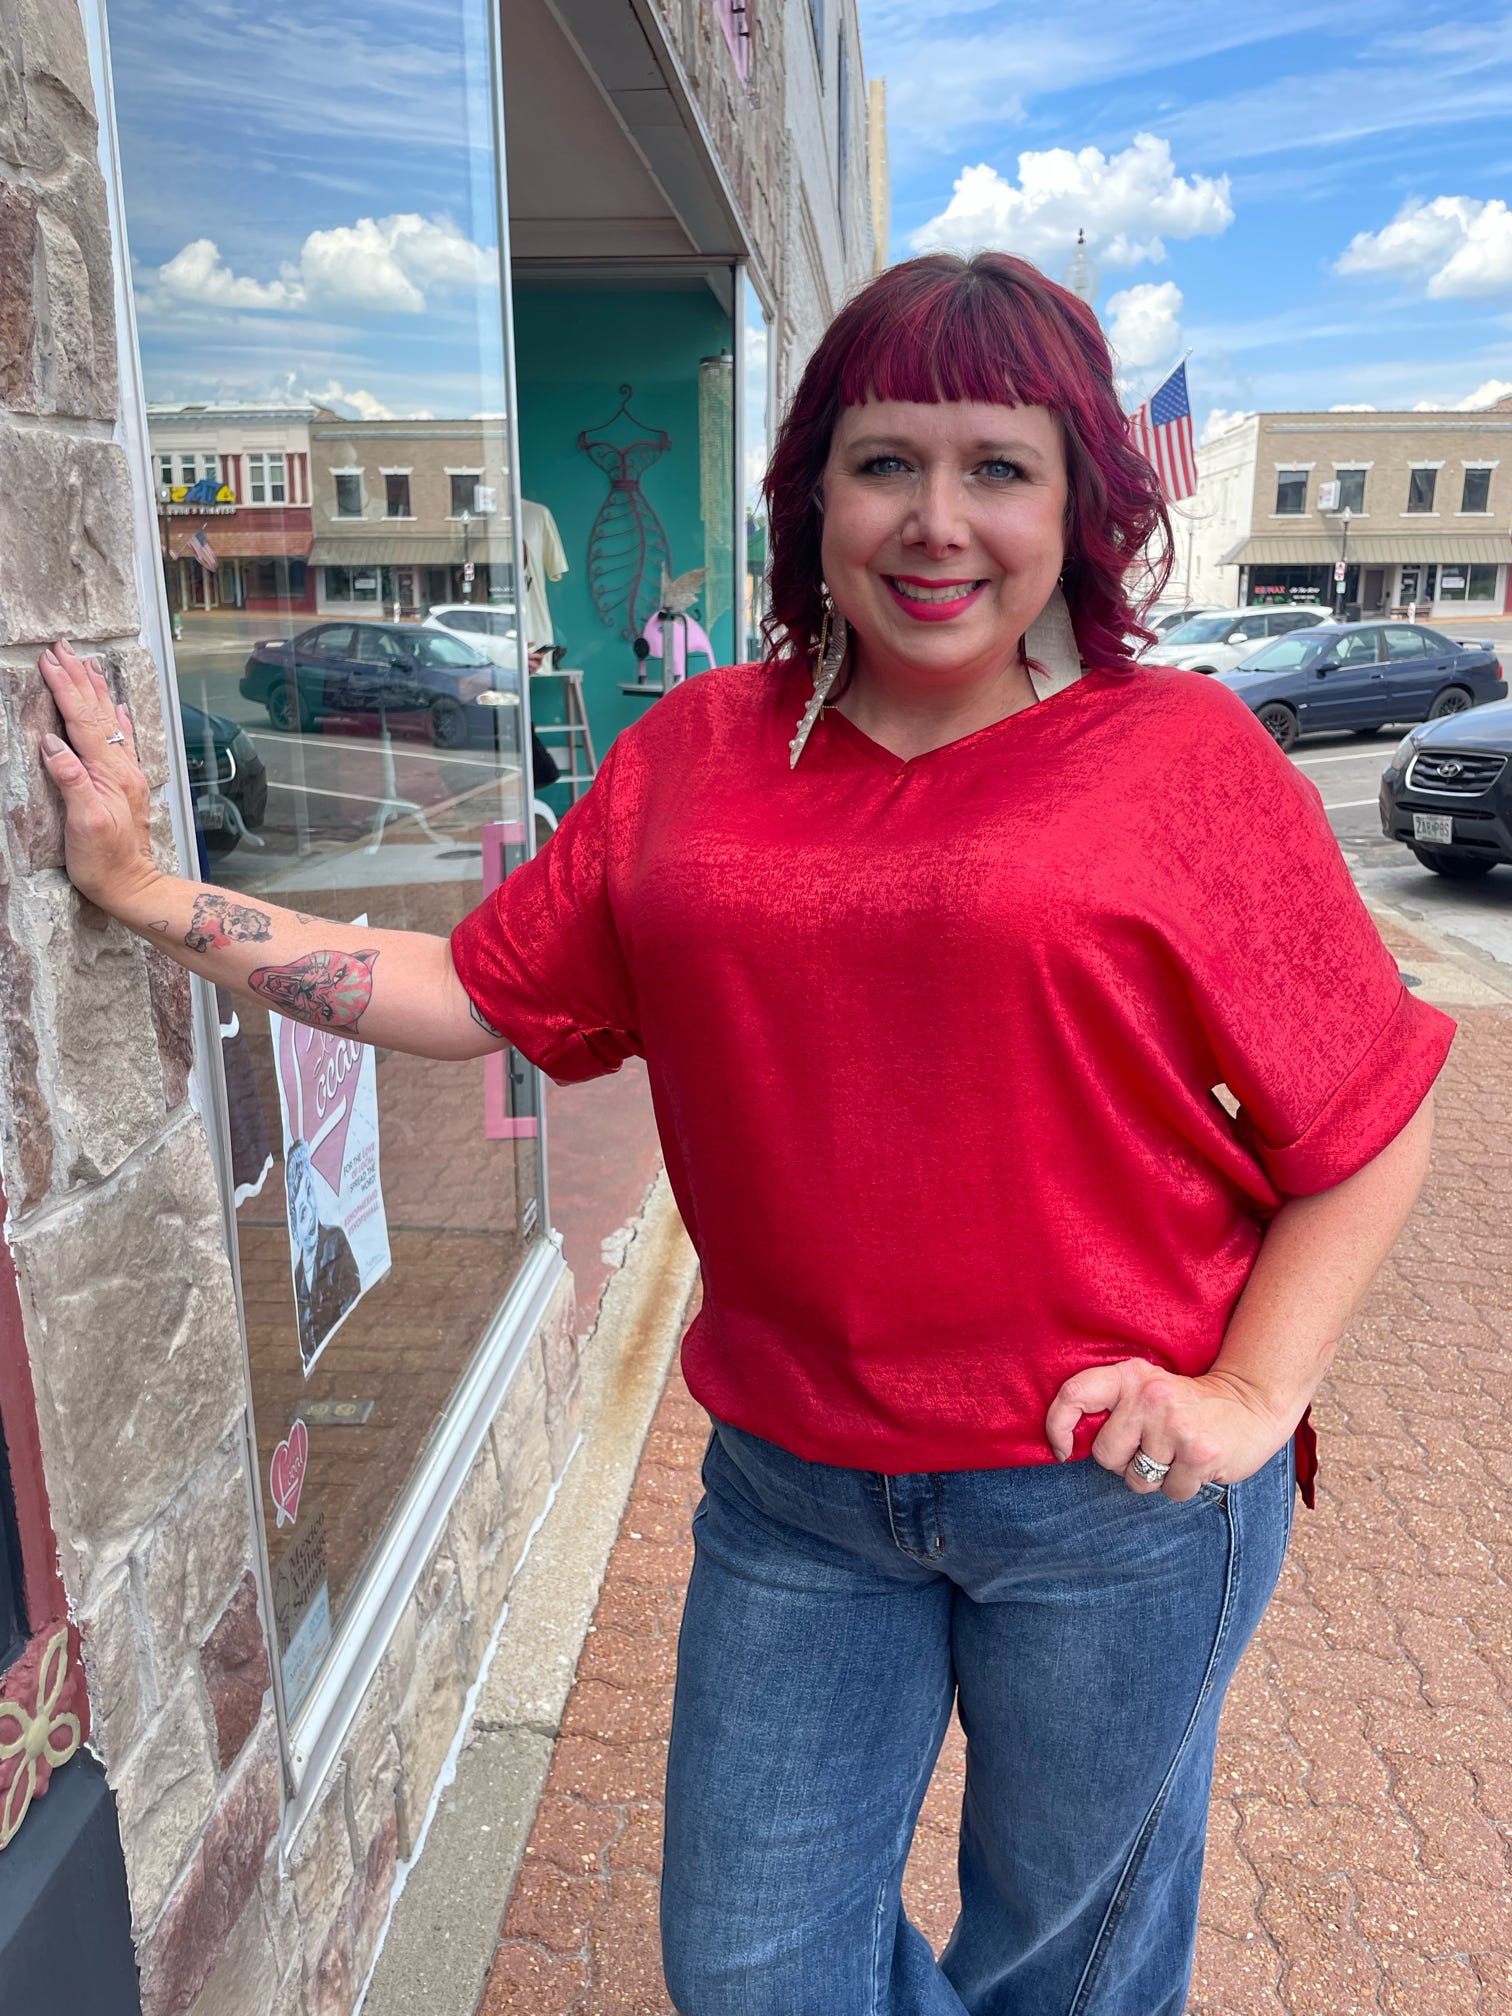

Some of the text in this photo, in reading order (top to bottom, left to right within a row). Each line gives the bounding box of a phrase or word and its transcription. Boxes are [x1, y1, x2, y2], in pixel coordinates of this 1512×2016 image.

[343, 1161, 353, 1177] FOR
[353, 1152, 361, 1165] THE
[290, 1512, 325, 1566] Mexico
[292, 1534, 326, 1588] Village
[293, 1555, 326, 1609] Square
